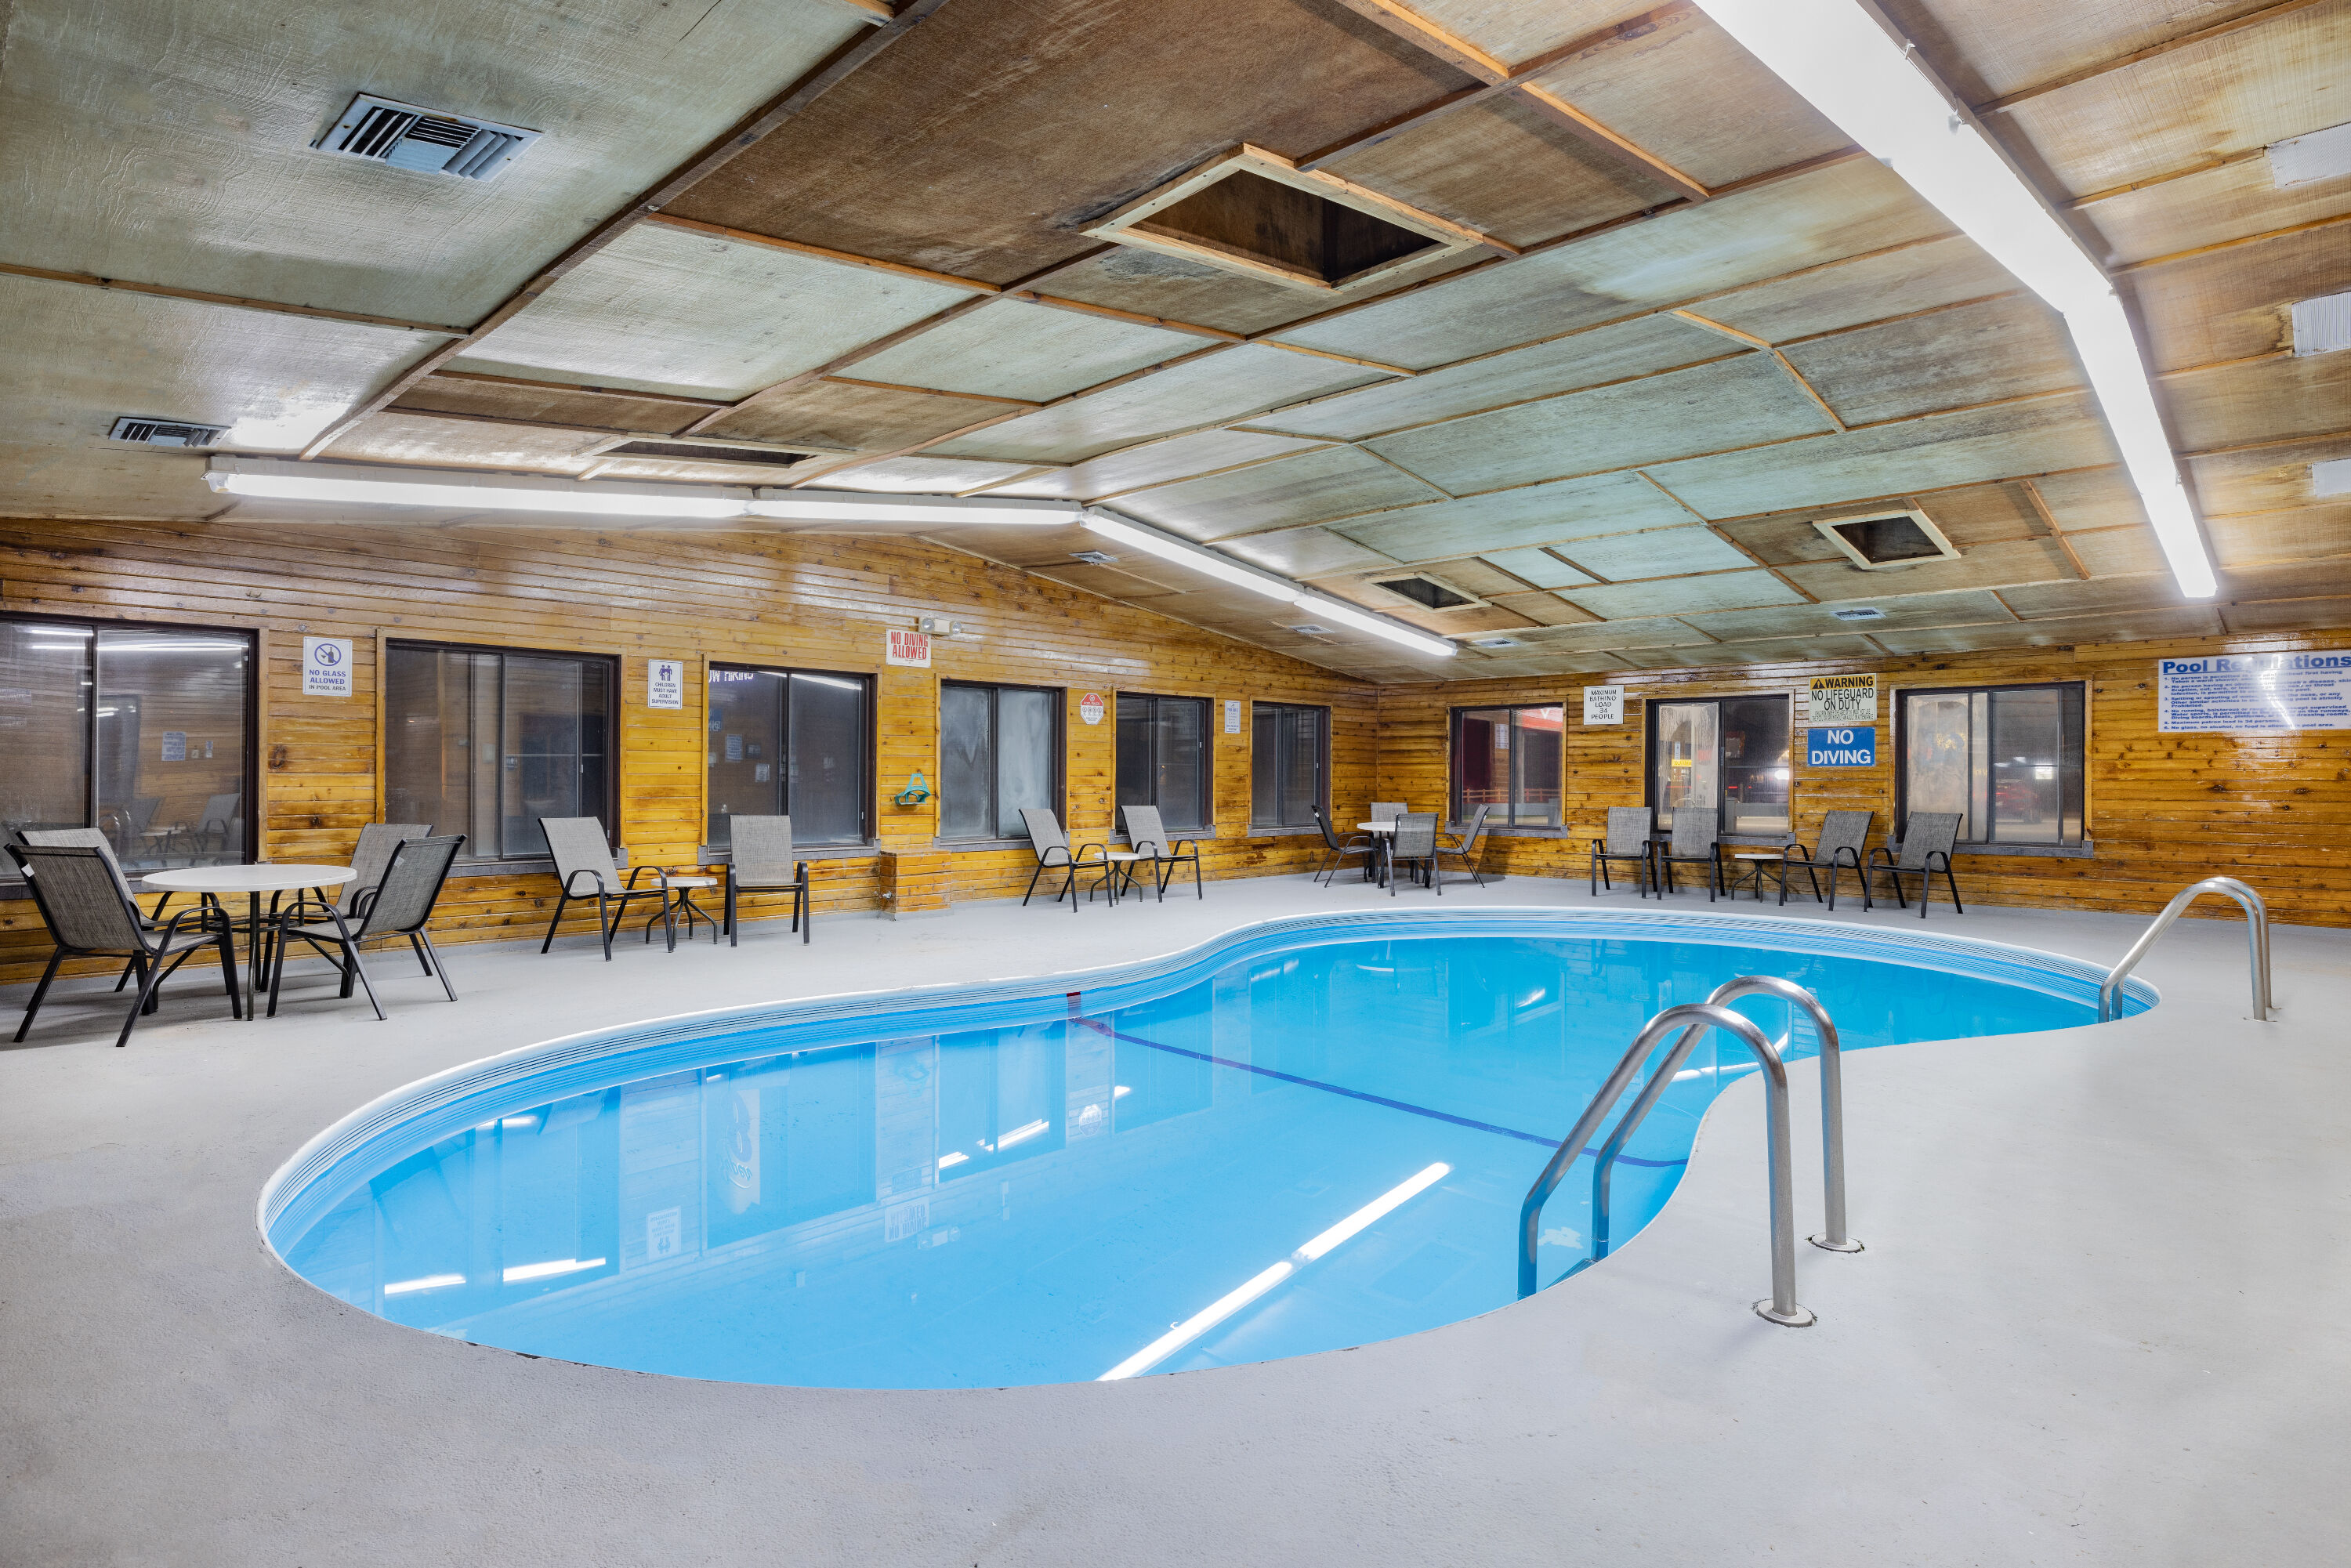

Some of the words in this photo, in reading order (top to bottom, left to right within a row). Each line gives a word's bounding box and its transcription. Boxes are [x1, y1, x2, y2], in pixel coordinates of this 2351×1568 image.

[890, 632, 901, 644] NO
[904, 632, 929, 647] DIVING
[892, 644, 927, 660] ALLOWED
[2163, 660, 2208, 674] Pool
[1824, 676, 1874, 688] WARNING
[1811, 690, 1824, 701] NO
[1826, 688, 1874, 701] LIFEGUARD
[1824, 700, 1836, 711] ON
[1838, 699, 1861, 711] DUTY
[1827, 730, 1854, 744] NO
[1811, 749, 1871, 765] DIVING
